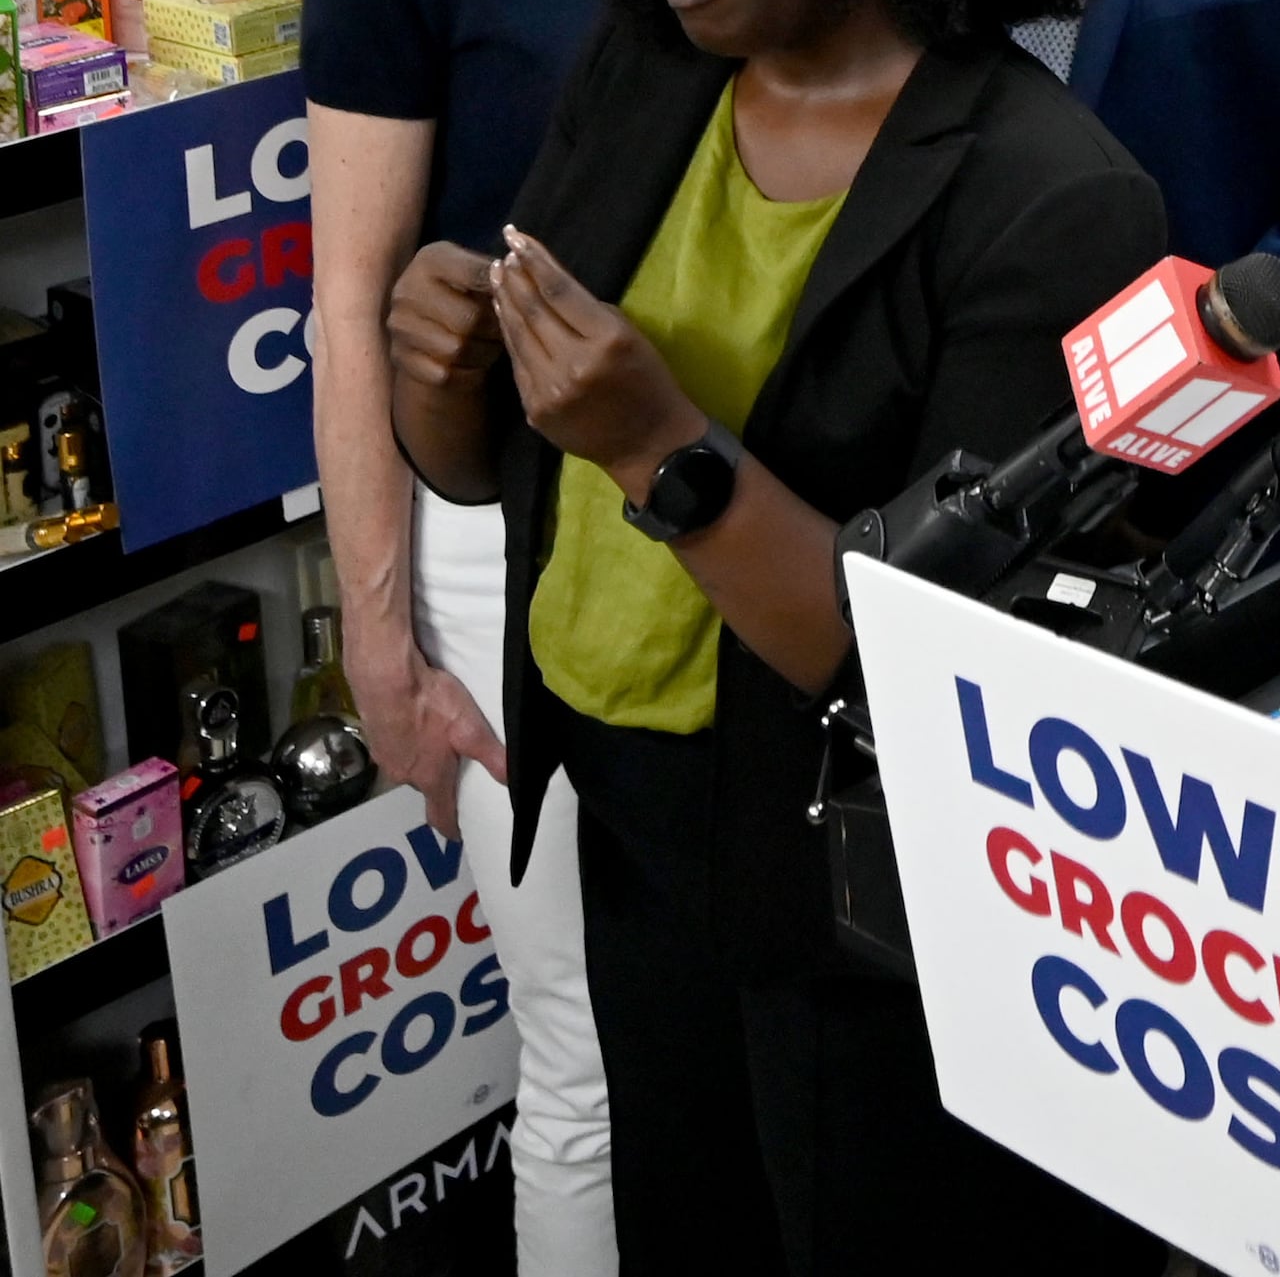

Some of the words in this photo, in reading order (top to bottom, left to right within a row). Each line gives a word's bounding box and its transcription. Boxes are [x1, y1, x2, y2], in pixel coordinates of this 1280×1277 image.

[1071, 335, 1112, 429] ALIVE
[1107, 432, 1192, 468] ALIVE
[262, 824, 463, 976] LOW
[280, 890, 492, 1042] GROC
[311, 953, 510, 1117] COS
[344, 1120, 514, 1259] ARMA
